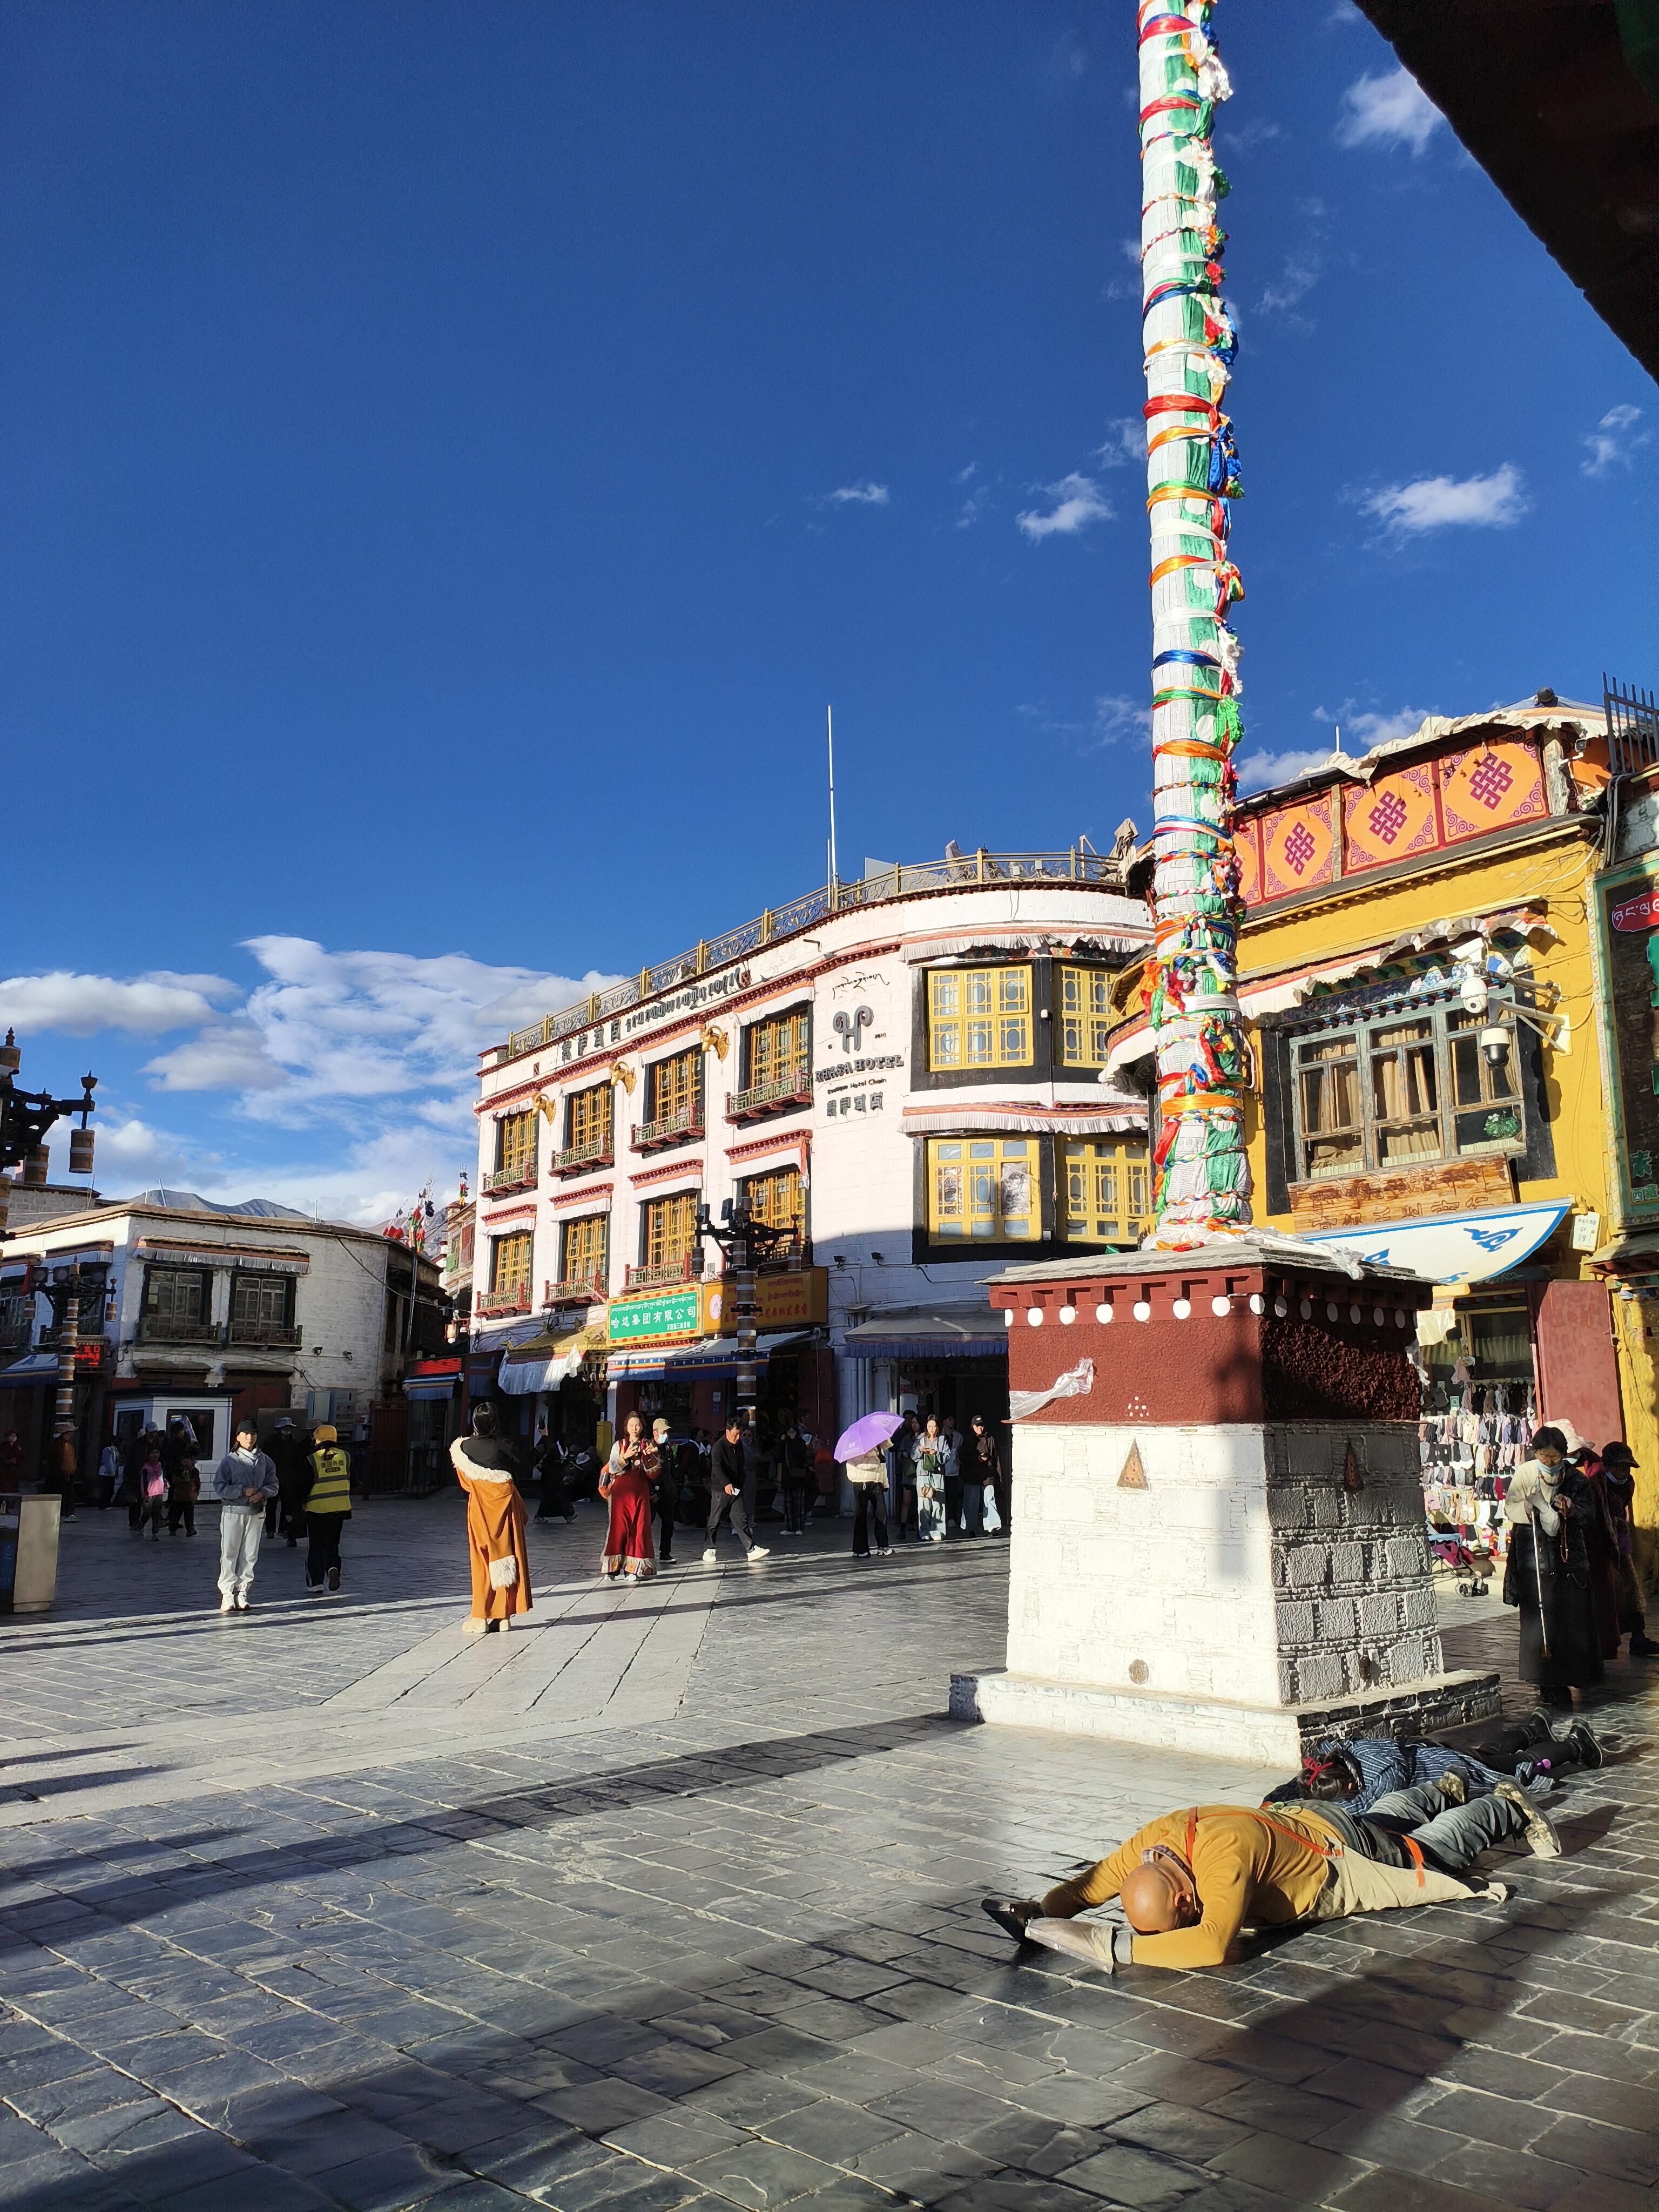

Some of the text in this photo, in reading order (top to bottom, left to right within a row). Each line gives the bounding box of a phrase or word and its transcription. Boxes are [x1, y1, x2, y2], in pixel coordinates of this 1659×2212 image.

[815, 1055, 904, 1083] RHASA HOTEL
[850, 1080, 866, 1088] Hotel
[611, 1305, 696, 1329] 哈达集团有限公司
